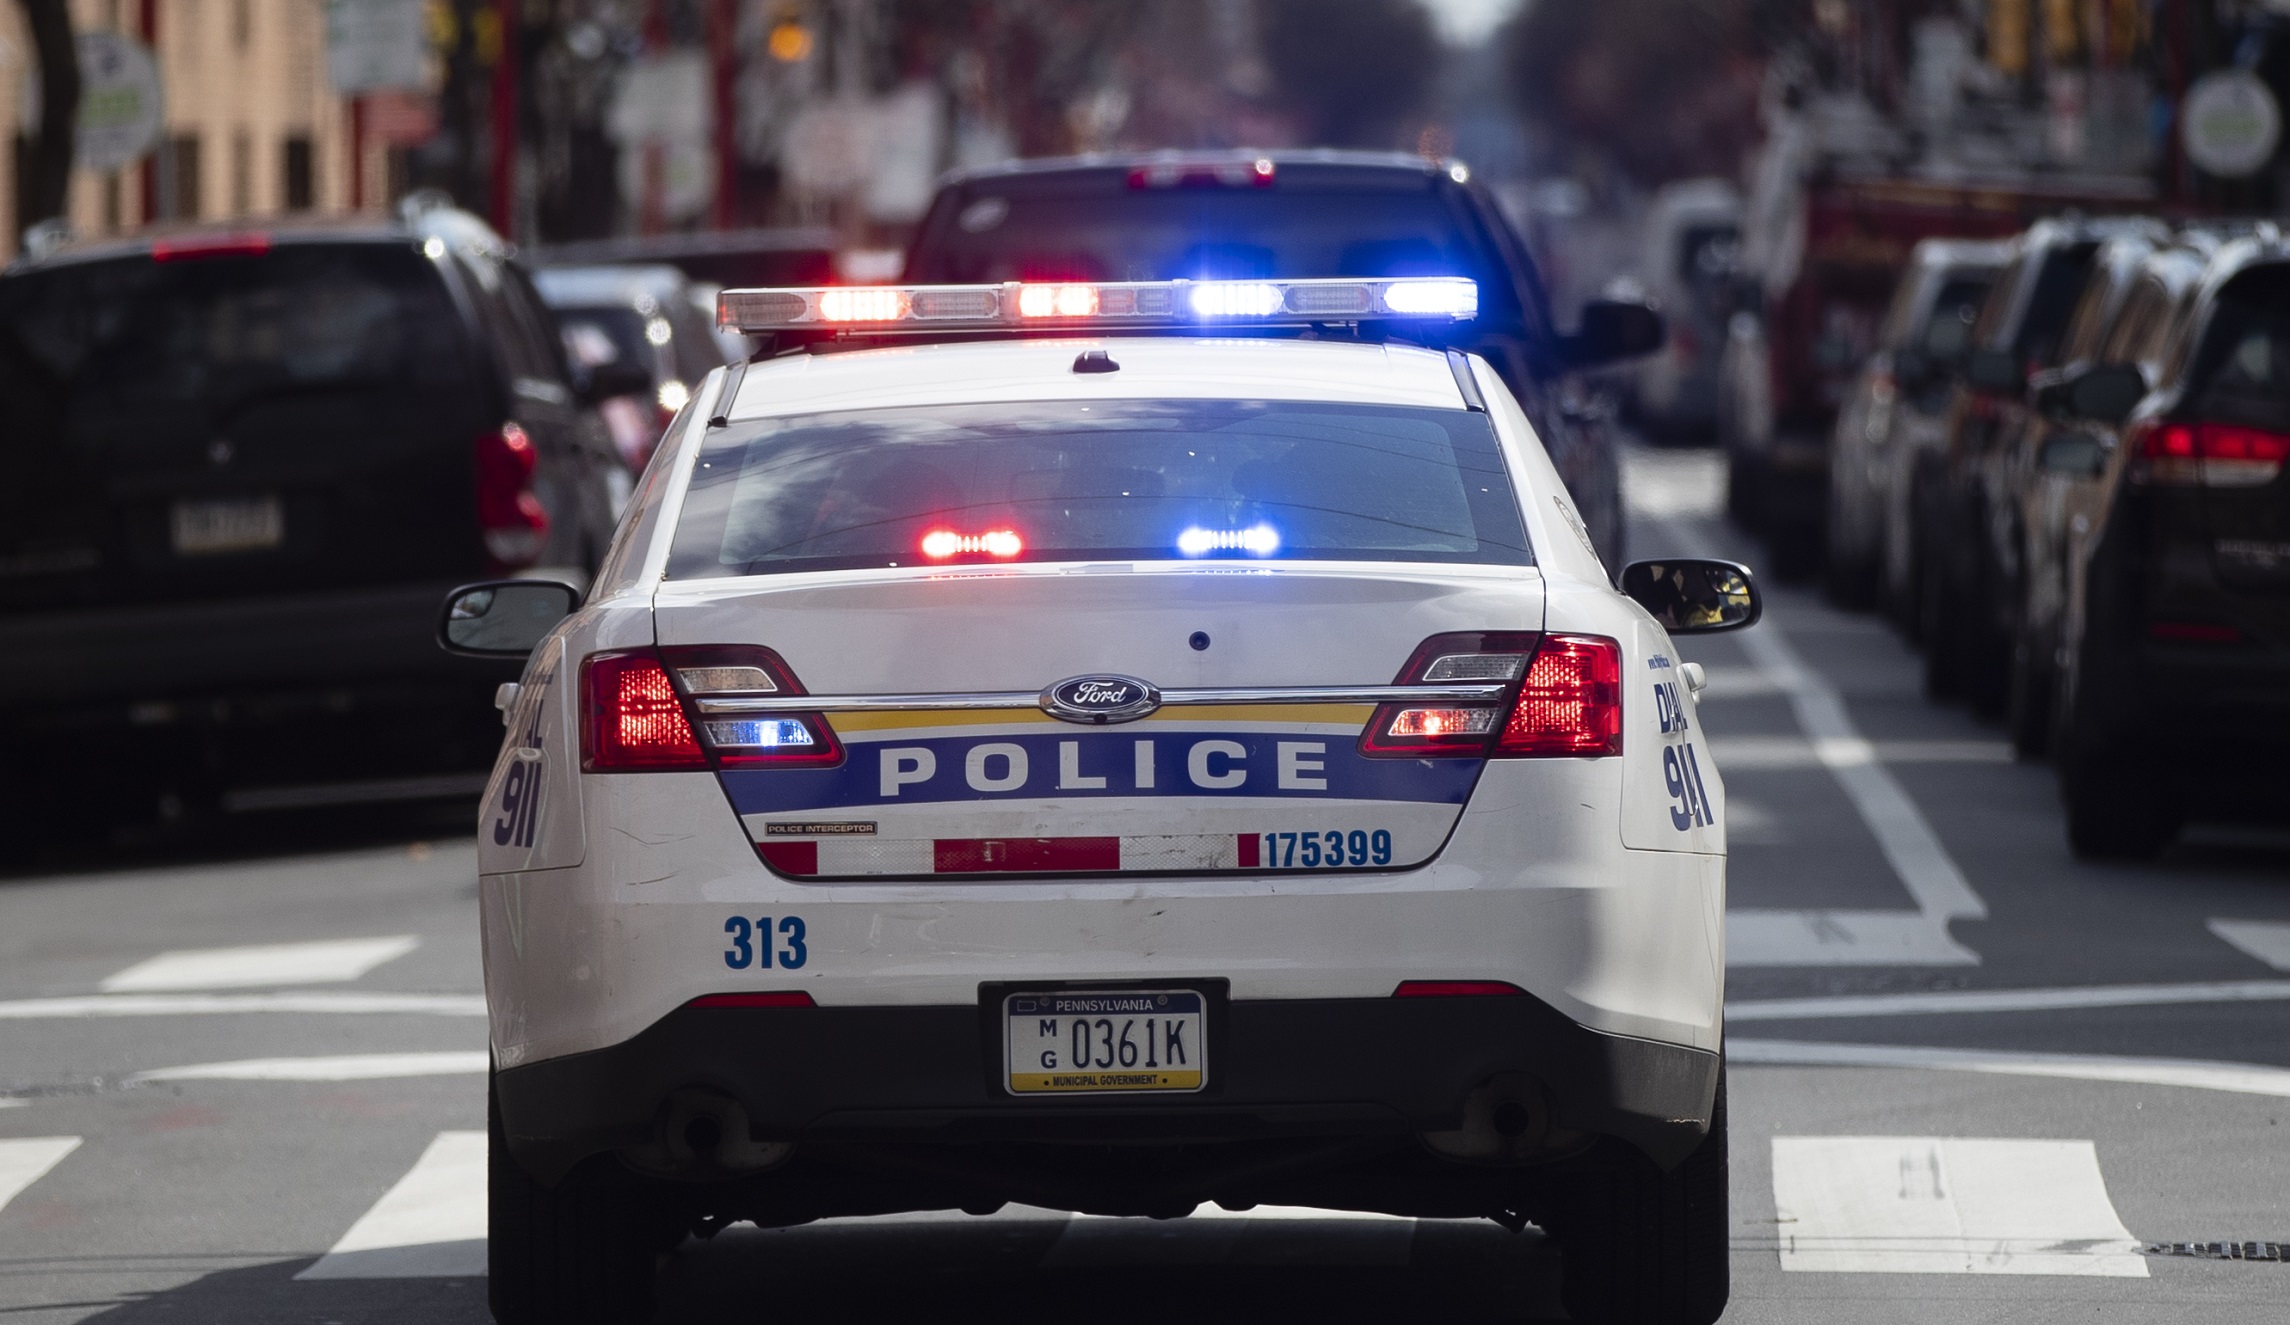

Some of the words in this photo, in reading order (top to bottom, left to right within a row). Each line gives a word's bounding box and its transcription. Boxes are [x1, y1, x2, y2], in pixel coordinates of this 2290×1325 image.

[1073, 681, 1128, 704] Ford
[1653, 682, 1688, 734] DIAL
[879, 739, 1328, 797] POLICE
[1662, 742, 1714, 832] 911
[493, 760, 543, 848] 911
[768, 825, 803, 833] POLICE
[805, 824, 874, 833] INTERCEPTOR
[1264, 829, 1392, 868] 175399
[724, 915, 808, 970] 313
[1055, 999, 1154, 1012] PENNSYLVANIA
[1072, 1018, 1187, 1069] 0361K
[1052, 1076, 1098, 1087] MUNICIPAL
[1099, 1074, 1158, 1086] GOVERNMENT
